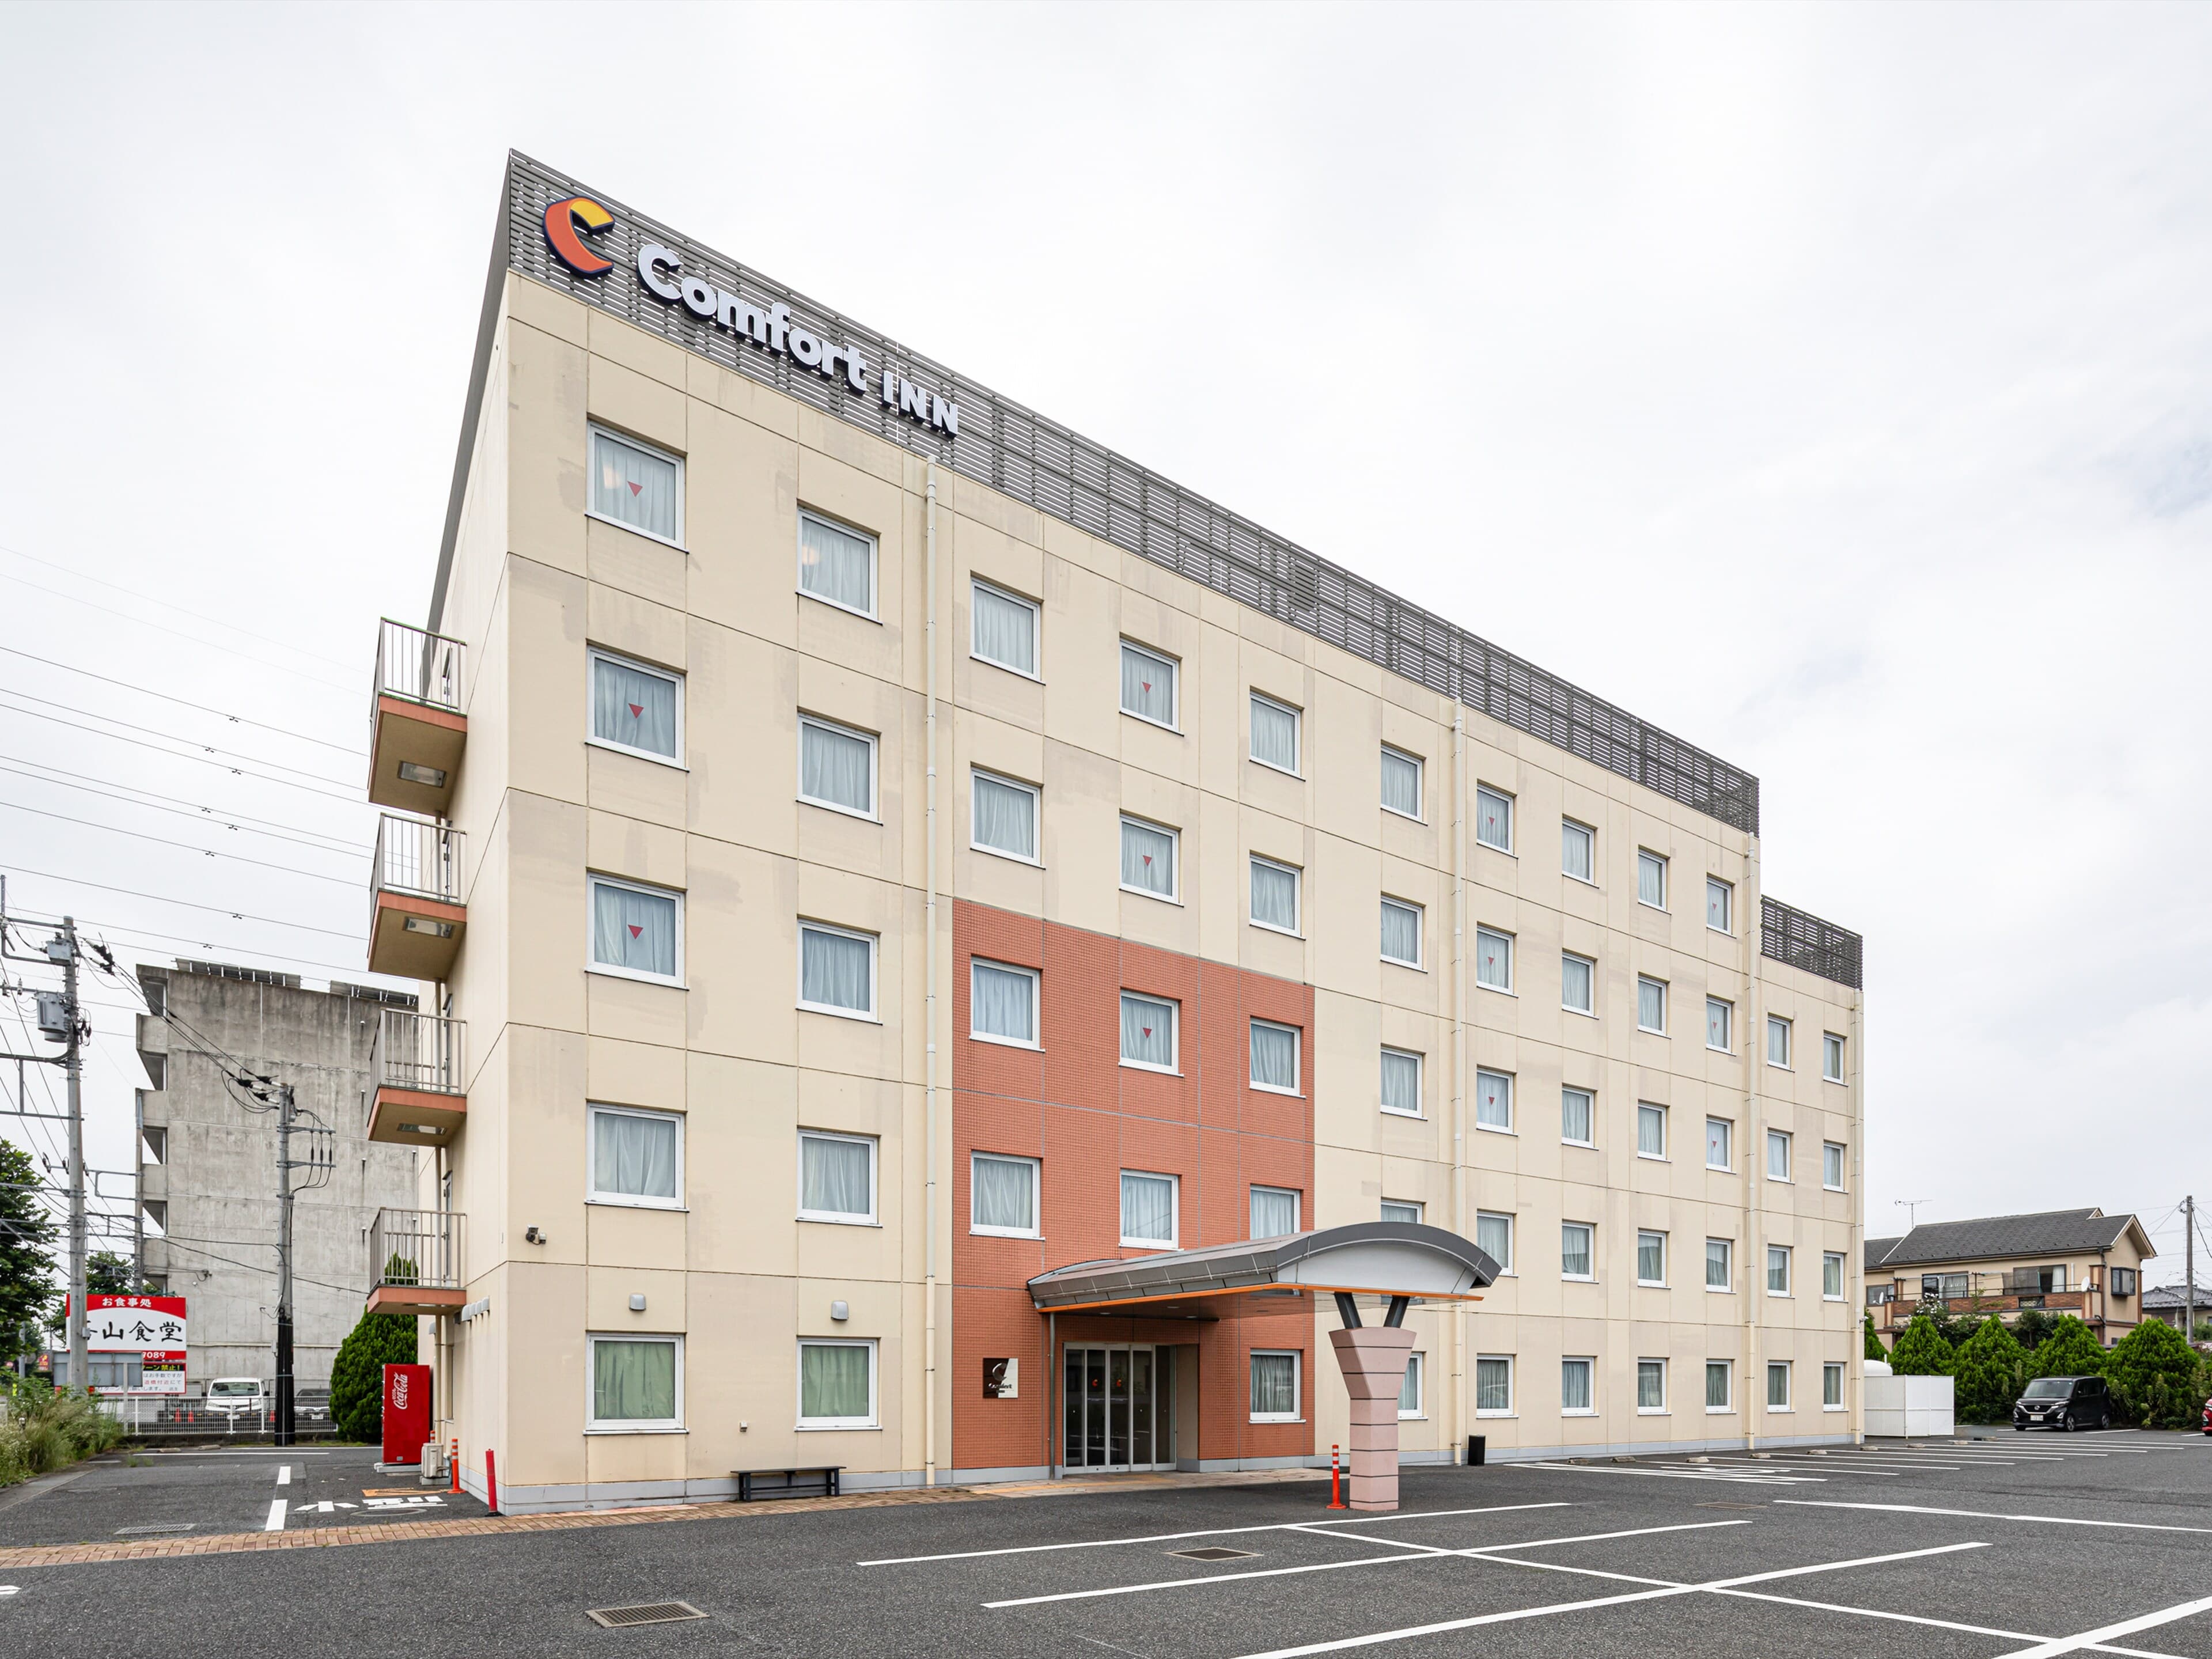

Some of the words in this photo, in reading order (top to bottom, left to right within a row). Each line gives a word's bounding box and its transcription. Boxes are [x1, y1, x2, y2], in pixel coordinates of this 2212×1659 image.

[637, 244, 867, 393] Comfort
[882, 370, 959, 436] INN
[102, 1297, 151, 1308] お食事処
[393, 1372, 408, 1410] Coca-Cola
